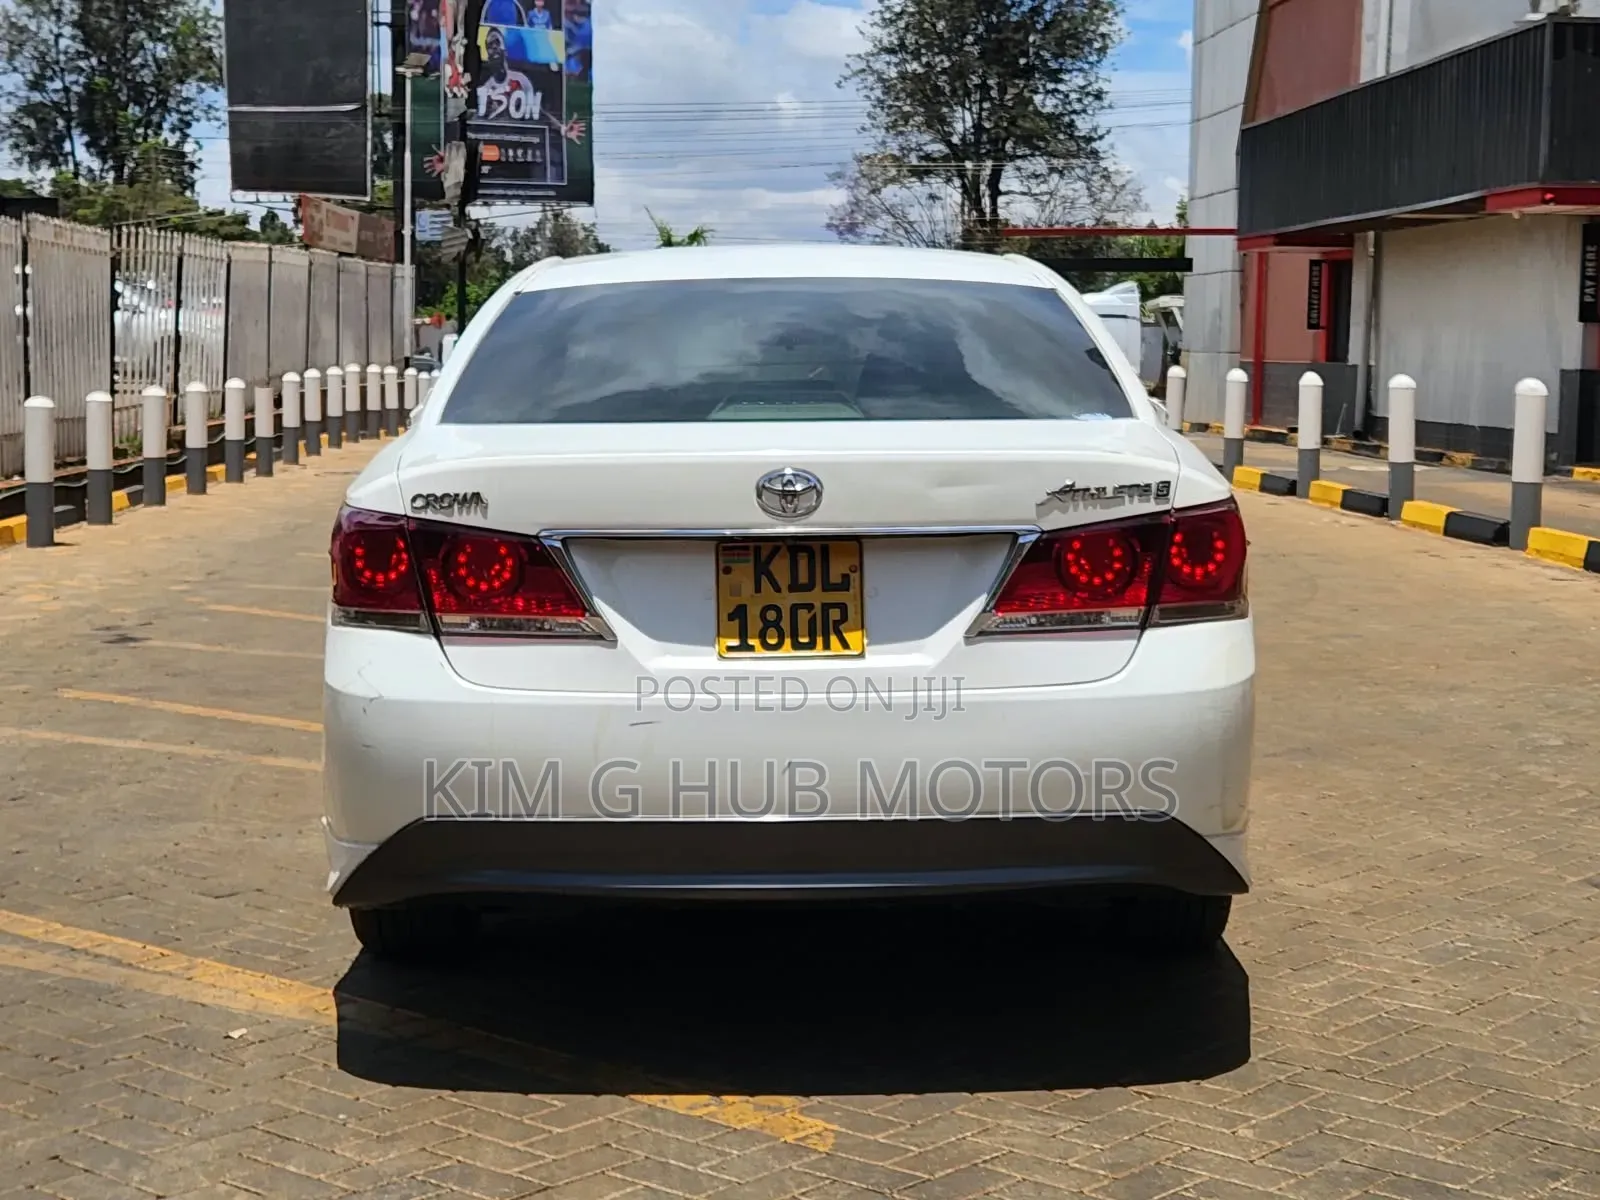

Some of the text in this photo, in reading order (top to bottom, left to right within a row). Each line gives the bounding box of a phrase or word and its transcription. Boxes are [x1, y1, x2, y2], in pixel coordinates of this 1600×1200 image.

[1584, 245, 1598, 302] PAY HERE
[410, 491, 488, 513] CROWN
[753, 544, 851, 593] KDL
[726, 602, 852, 652] 180R
